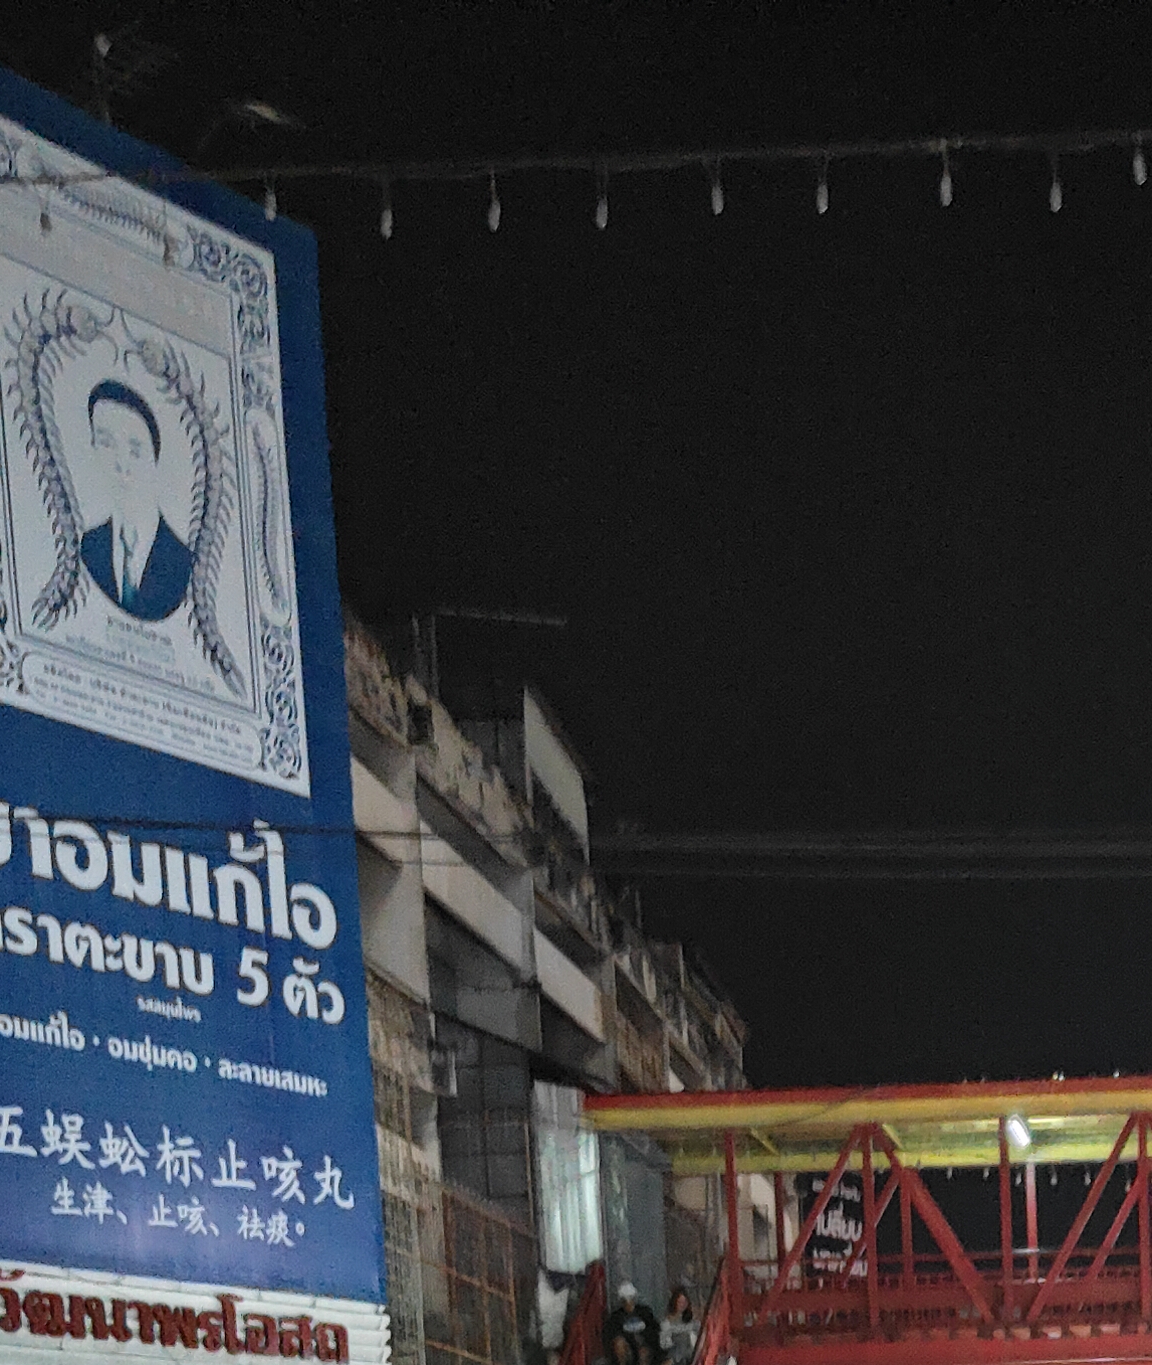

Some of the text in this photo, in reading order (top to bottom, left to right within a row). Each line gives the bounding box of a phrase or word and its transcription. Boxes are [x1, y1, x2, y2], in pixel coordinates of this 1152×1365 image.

[0, 802, 337, 950] าอมแก้ไอ
[0, 906, 345, 1024] ราตะขาบ 5 ตัว
